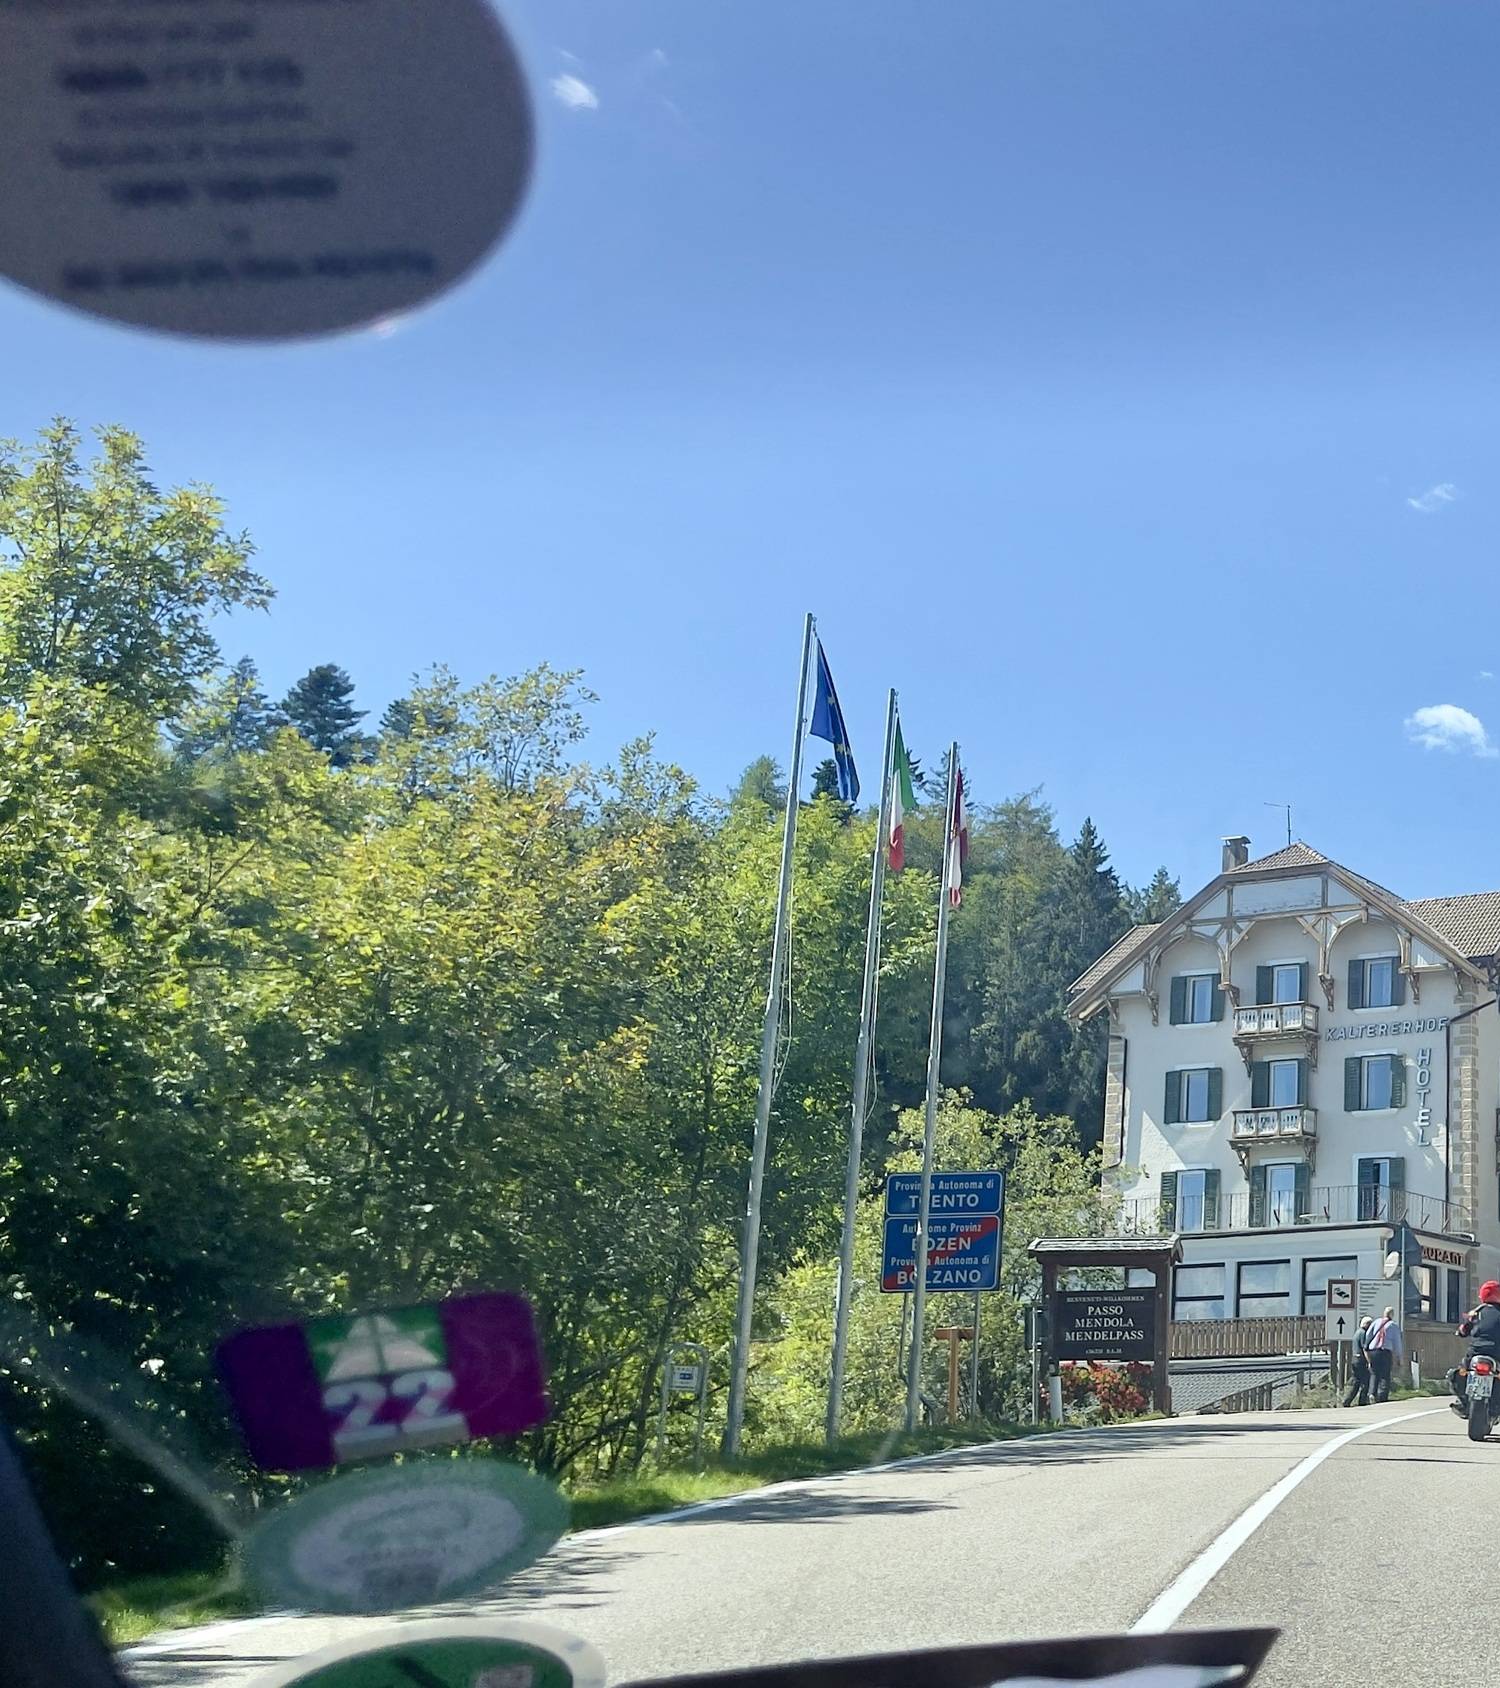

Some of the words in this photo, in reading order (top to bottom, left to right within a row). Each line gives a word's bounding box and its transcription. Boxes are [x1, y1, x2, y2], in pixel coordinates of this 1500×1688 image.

[1326, 1017, 1449, 1041] KALTERERHOF
[1417, 1048, 1432, 1147] HOTEL
[895, 1181, 935, 1191] Provina
[939, 1180, 983, 1190] Autonoma
[986, 1178, 994, 1189] di
[909, 1193, 979, 1208] TENTO
[903, 1223, 947, 1233] Autome
[950, 1222, 982, 1233] Provinz
[891, 1256, 931, 1266] Provia
[934, 1256, 978, 1266] Autonoma
[981, 1255, 990, 1265] di
[1088, 1305, 1124, 1316] PASSO
[1074, 1317, 1134, 1328] MENDOLA
[1065, 1330, 1144, 1341] MENDELPASS
[323, 1370, 464, 1445] 22
